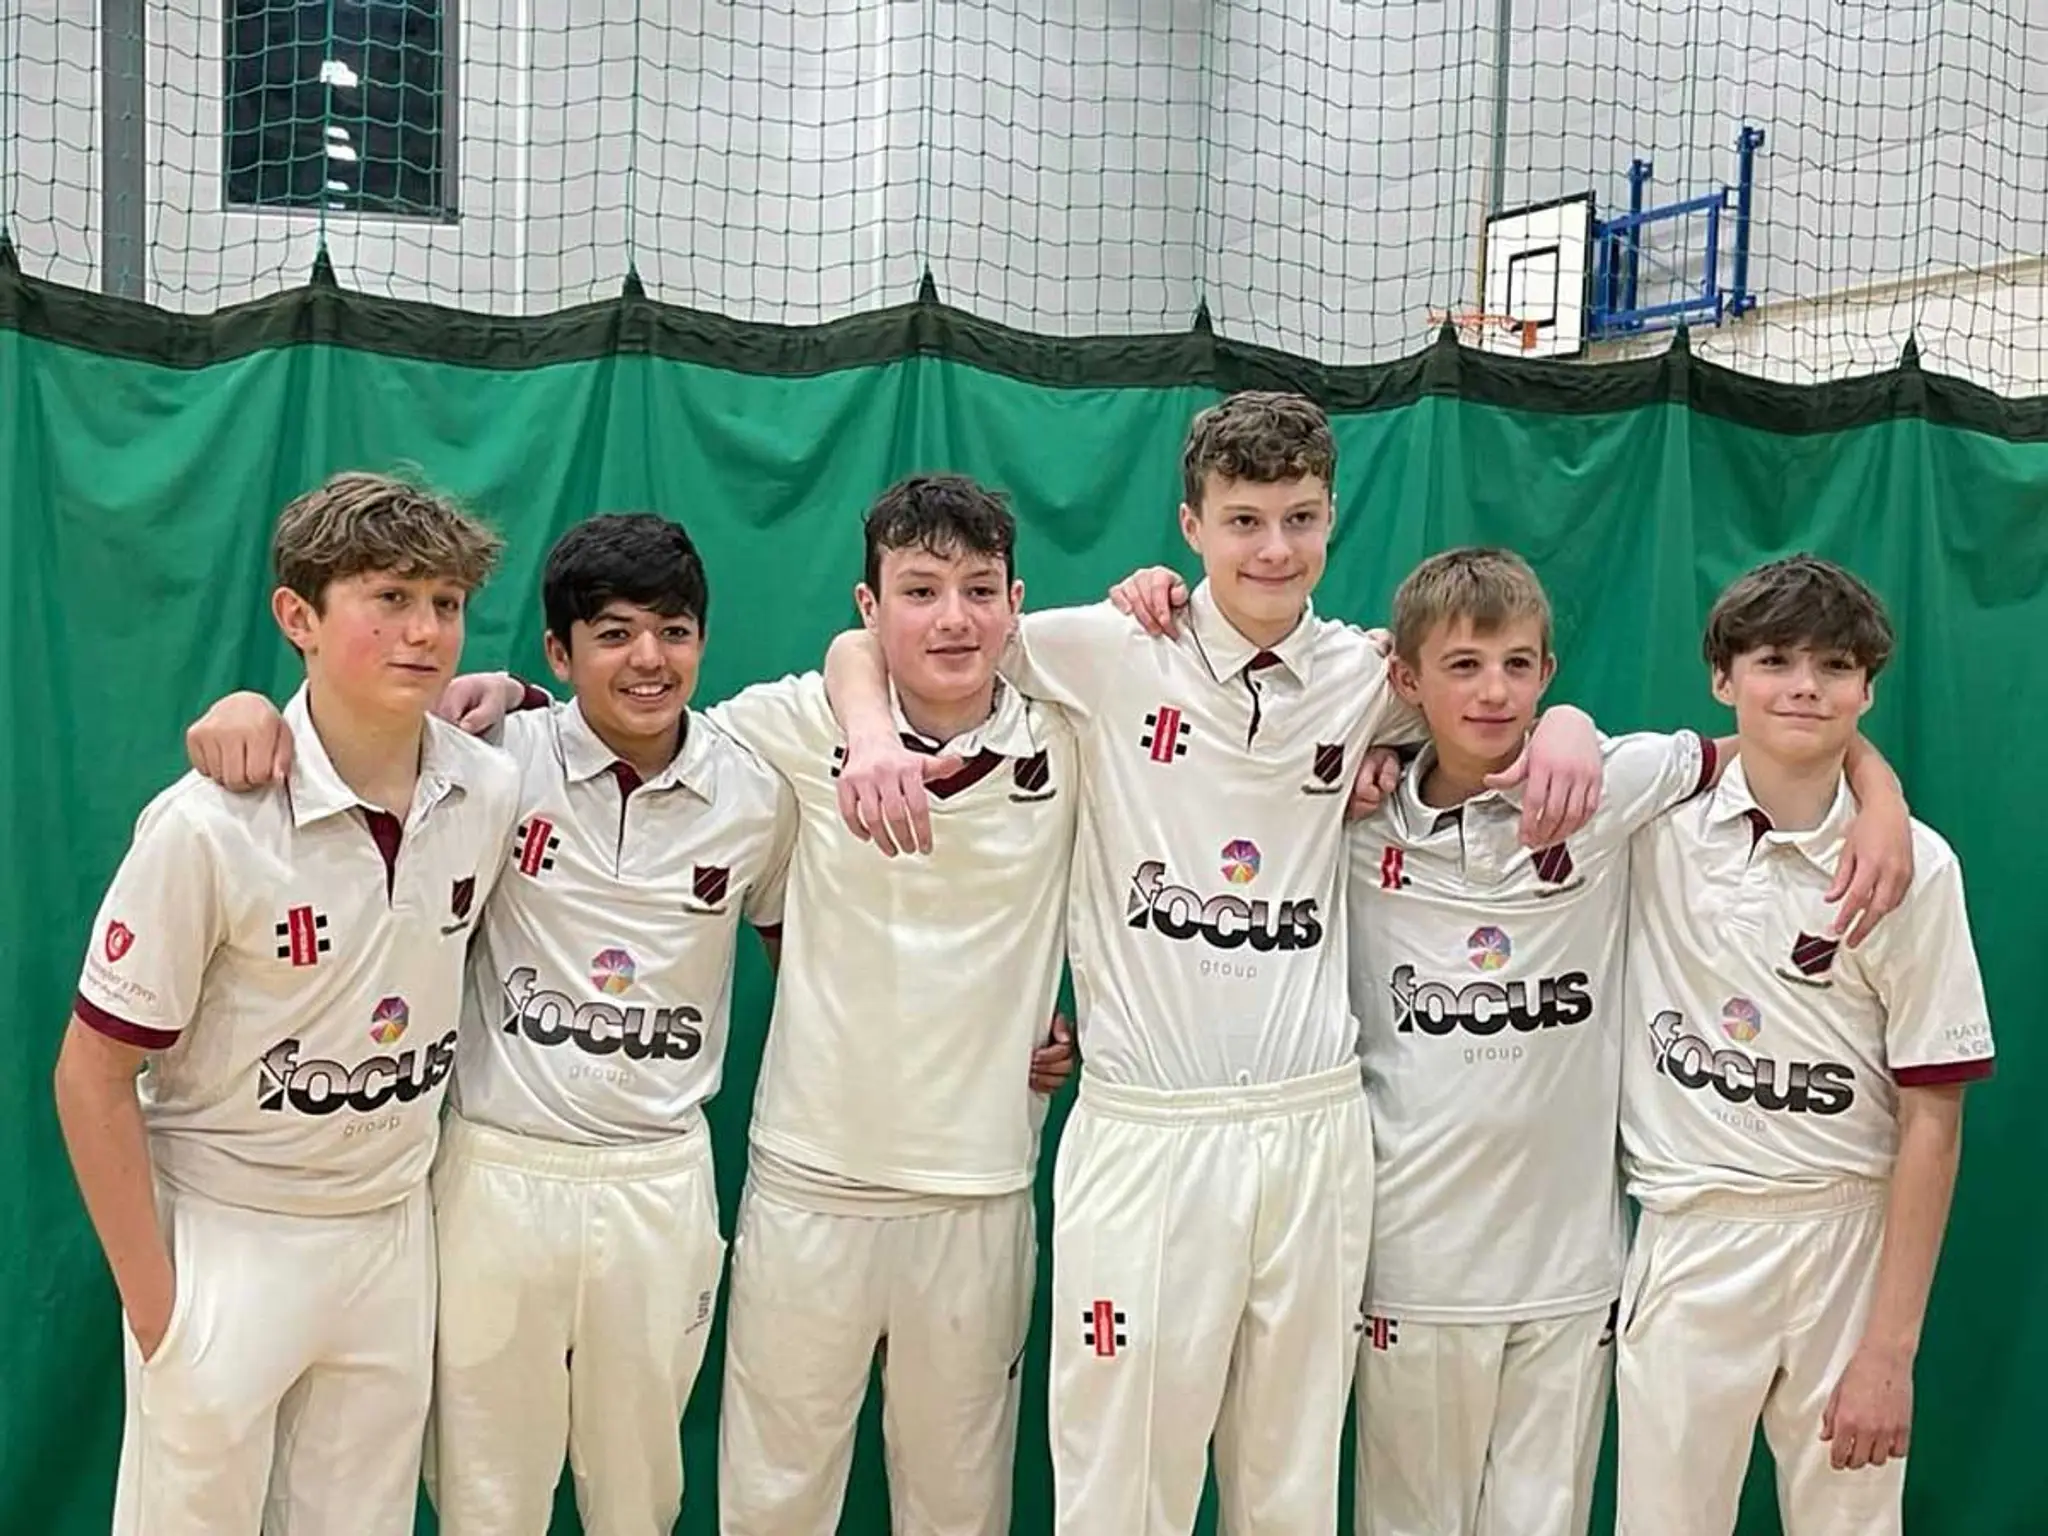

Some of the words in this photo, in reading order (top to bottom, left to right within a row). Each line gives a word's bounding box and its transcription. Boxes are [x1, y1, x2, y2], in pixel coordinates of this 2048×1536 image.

[1127, 860, 1323, 952] focus
[1200, 958, 1258, 978] group
[1390, 964, 1593, 1035] focus
[503, 966, 703, 1060] focus
[1464, 1046, 1523, 1063] group
[258, 1030, 457, 1115] focus
[1649, 1010, 1855, 1115] focus
